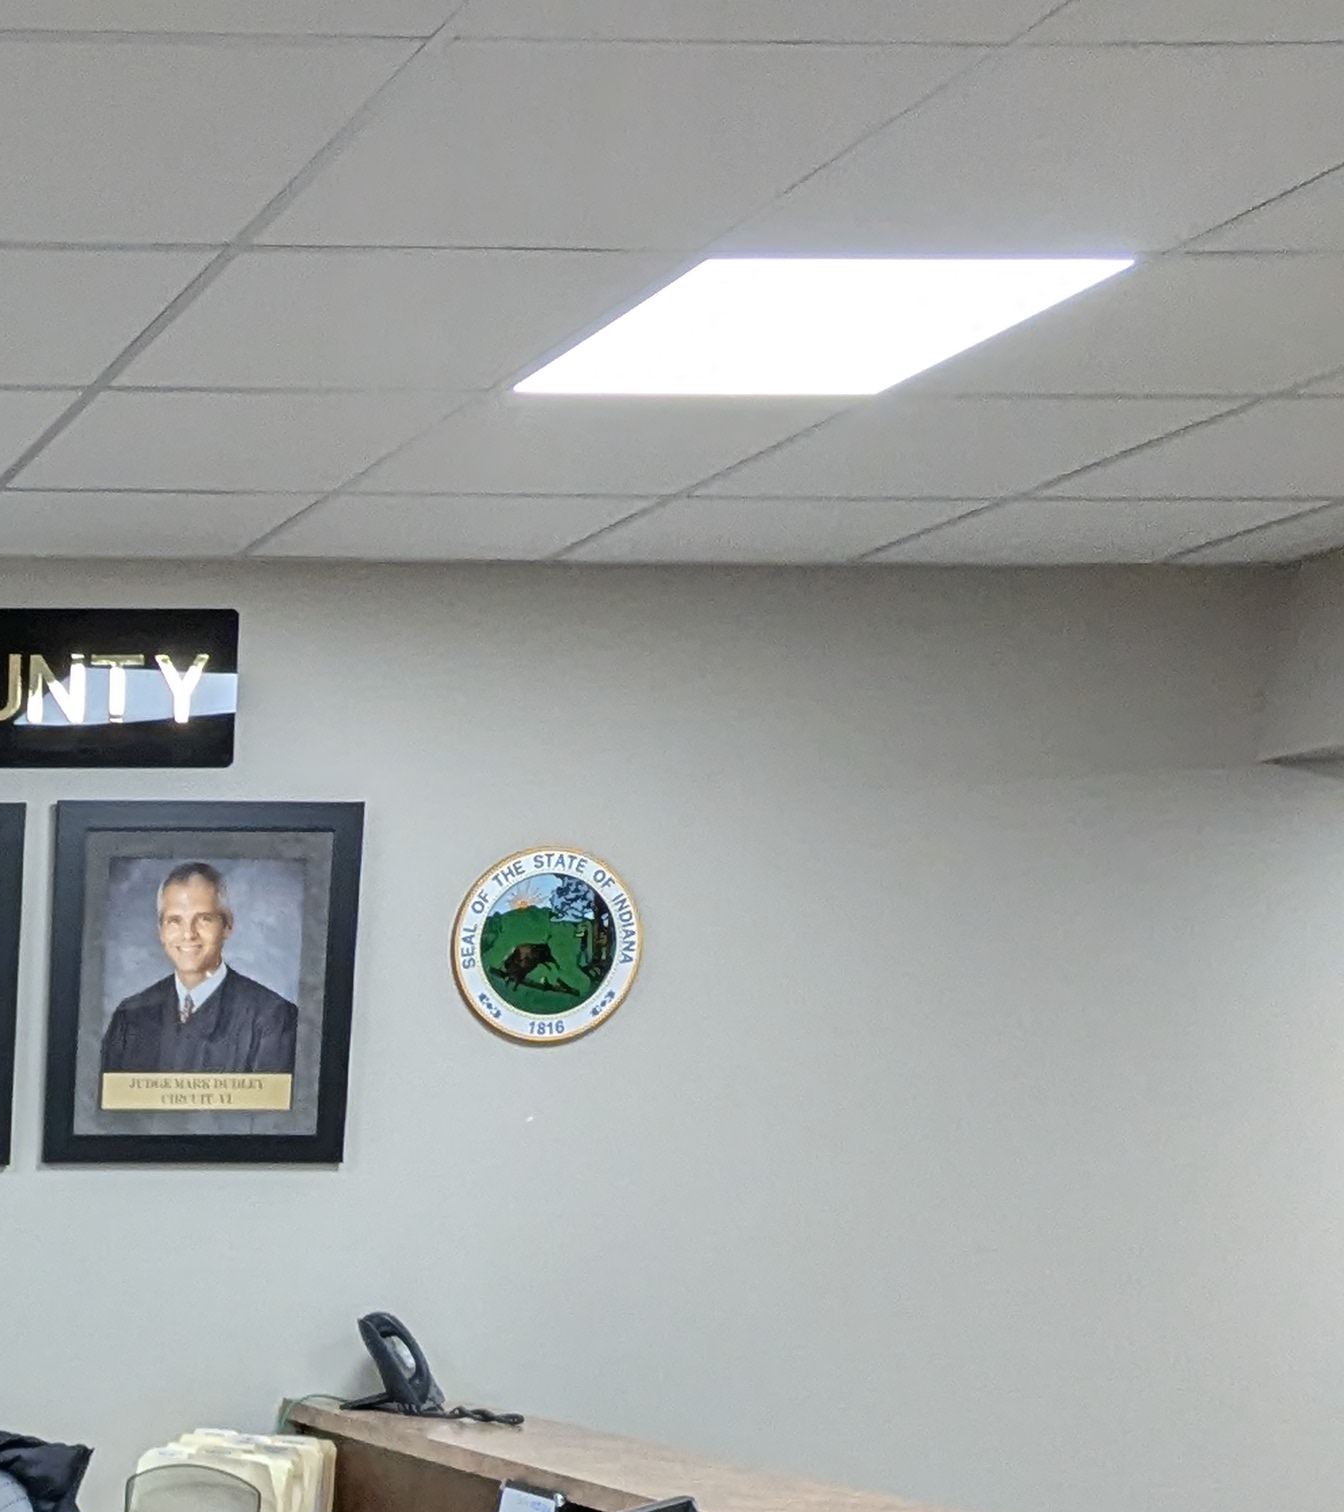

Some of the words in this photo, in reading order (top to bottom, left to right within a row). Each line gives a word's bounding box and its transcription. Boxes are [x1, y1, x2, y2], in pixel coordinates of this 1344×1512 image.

[461, 924, 477, 970] SEAL
[472, 891, 491, 915] OF
[492, 861, 526, 887] THE
[533, 853, 588, 873] STATE
[592, 870, 616, 890] OF
[612, 893, 638, 965] INDIANA
[528, 1020, 565, 1036] 1816
[129, 1078, 172, 1090] JUDGE
[175, 1078, 212, 1090] MARK
[162, 1093, 213, 1105] CIRCUIT
